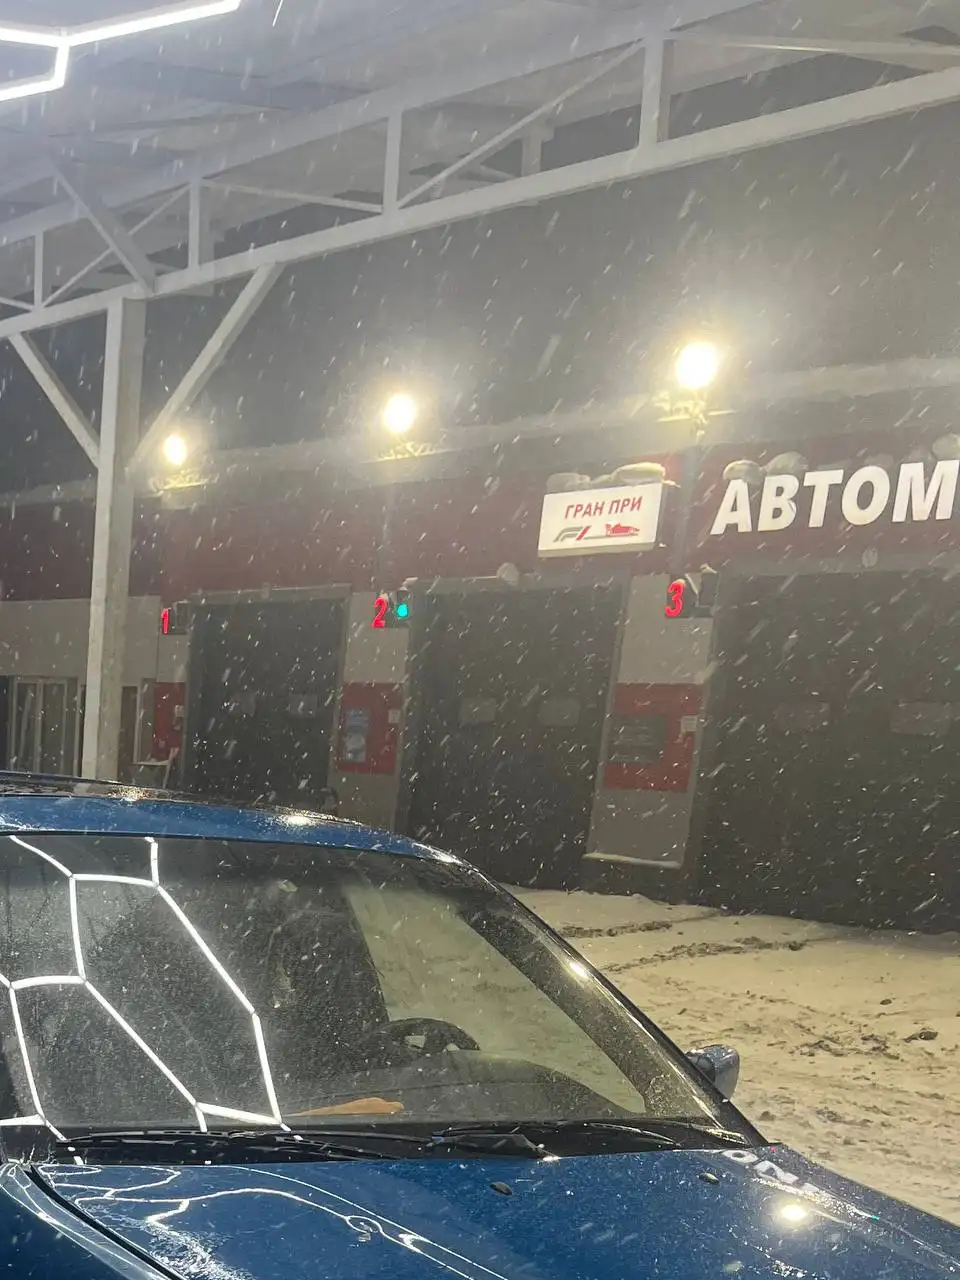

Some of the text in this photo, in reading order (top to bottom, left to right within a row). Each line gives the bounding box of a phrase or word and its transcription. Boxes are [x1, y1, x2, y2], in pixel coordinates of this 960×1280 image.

[564, 496, 643, 519] ГРАН ПРИ
[710, 460, 959, 535] АВТОМ
[371, 596, 389, 628] 2
[664, 579, 686, 618] 3
[160, 607, 170, 635] 1
